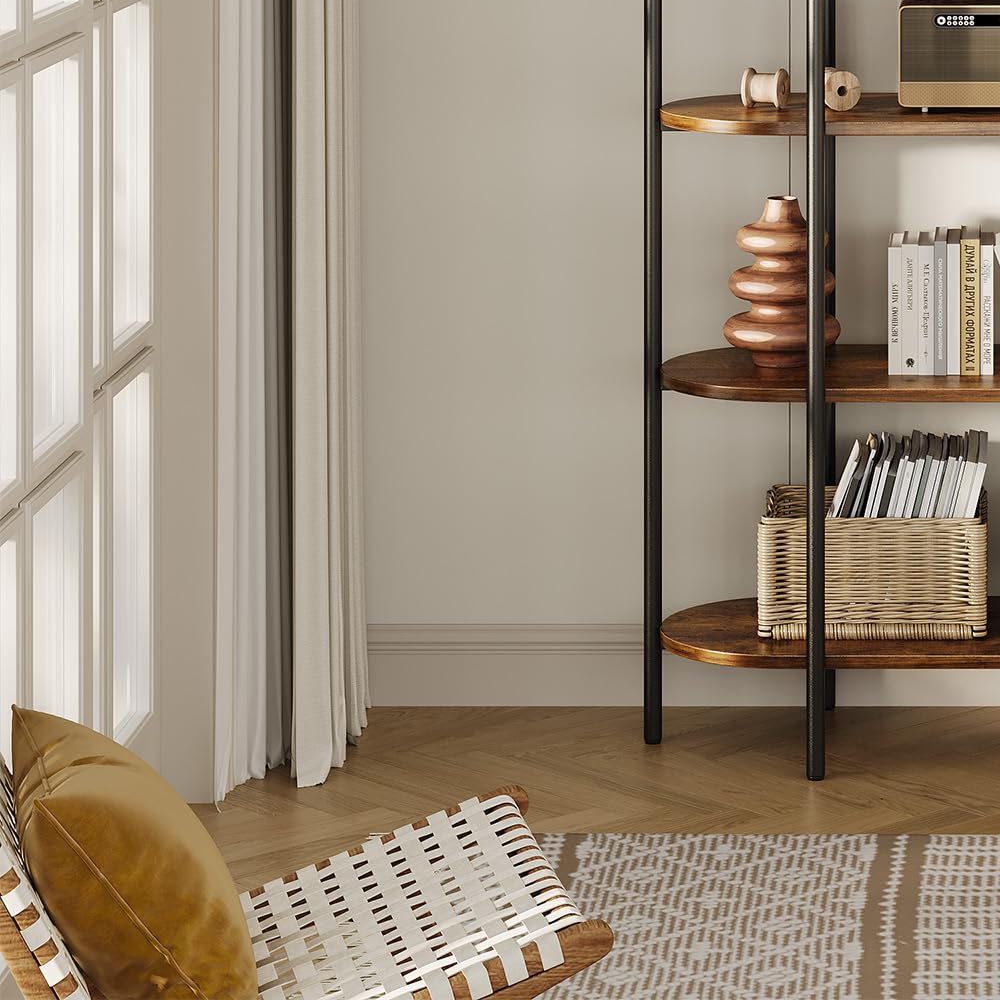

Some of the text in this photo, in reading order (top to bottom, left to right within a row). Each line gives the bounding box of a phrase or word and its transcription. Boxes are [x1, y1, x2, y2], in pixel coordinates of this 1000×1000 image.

[964, 245, 977, 274] ДУМАЙ
[964, 285, 975, 317] ДРУГИХ
[965, 320, 975, 363] ФОРМАТАХ
